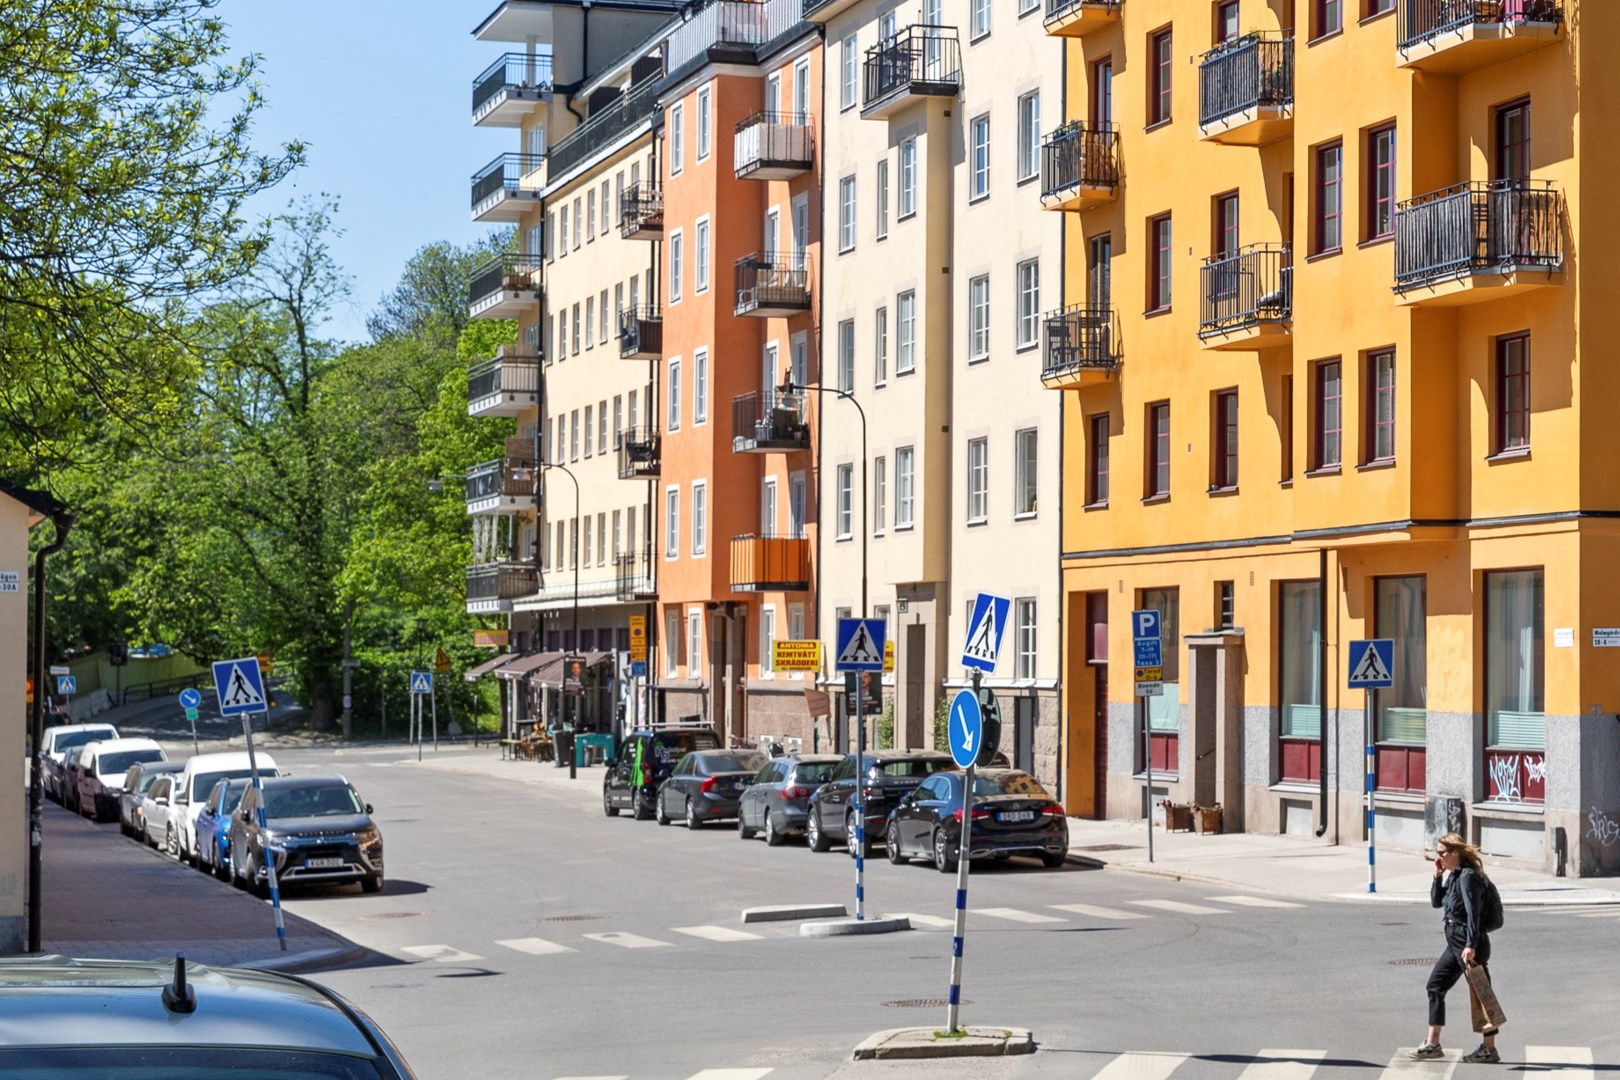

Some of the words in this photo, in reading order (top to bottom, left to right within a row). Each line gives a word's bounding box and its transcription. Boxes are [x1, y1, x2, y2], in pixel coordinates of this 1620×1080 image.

[1139, 613, 1155, 637] P
[1137, 640, 1158, 648] Avgift
[776, 650, 816, 658] KEMTVÄTT
[775, 659, 818, 667] SKRÄDDERI
